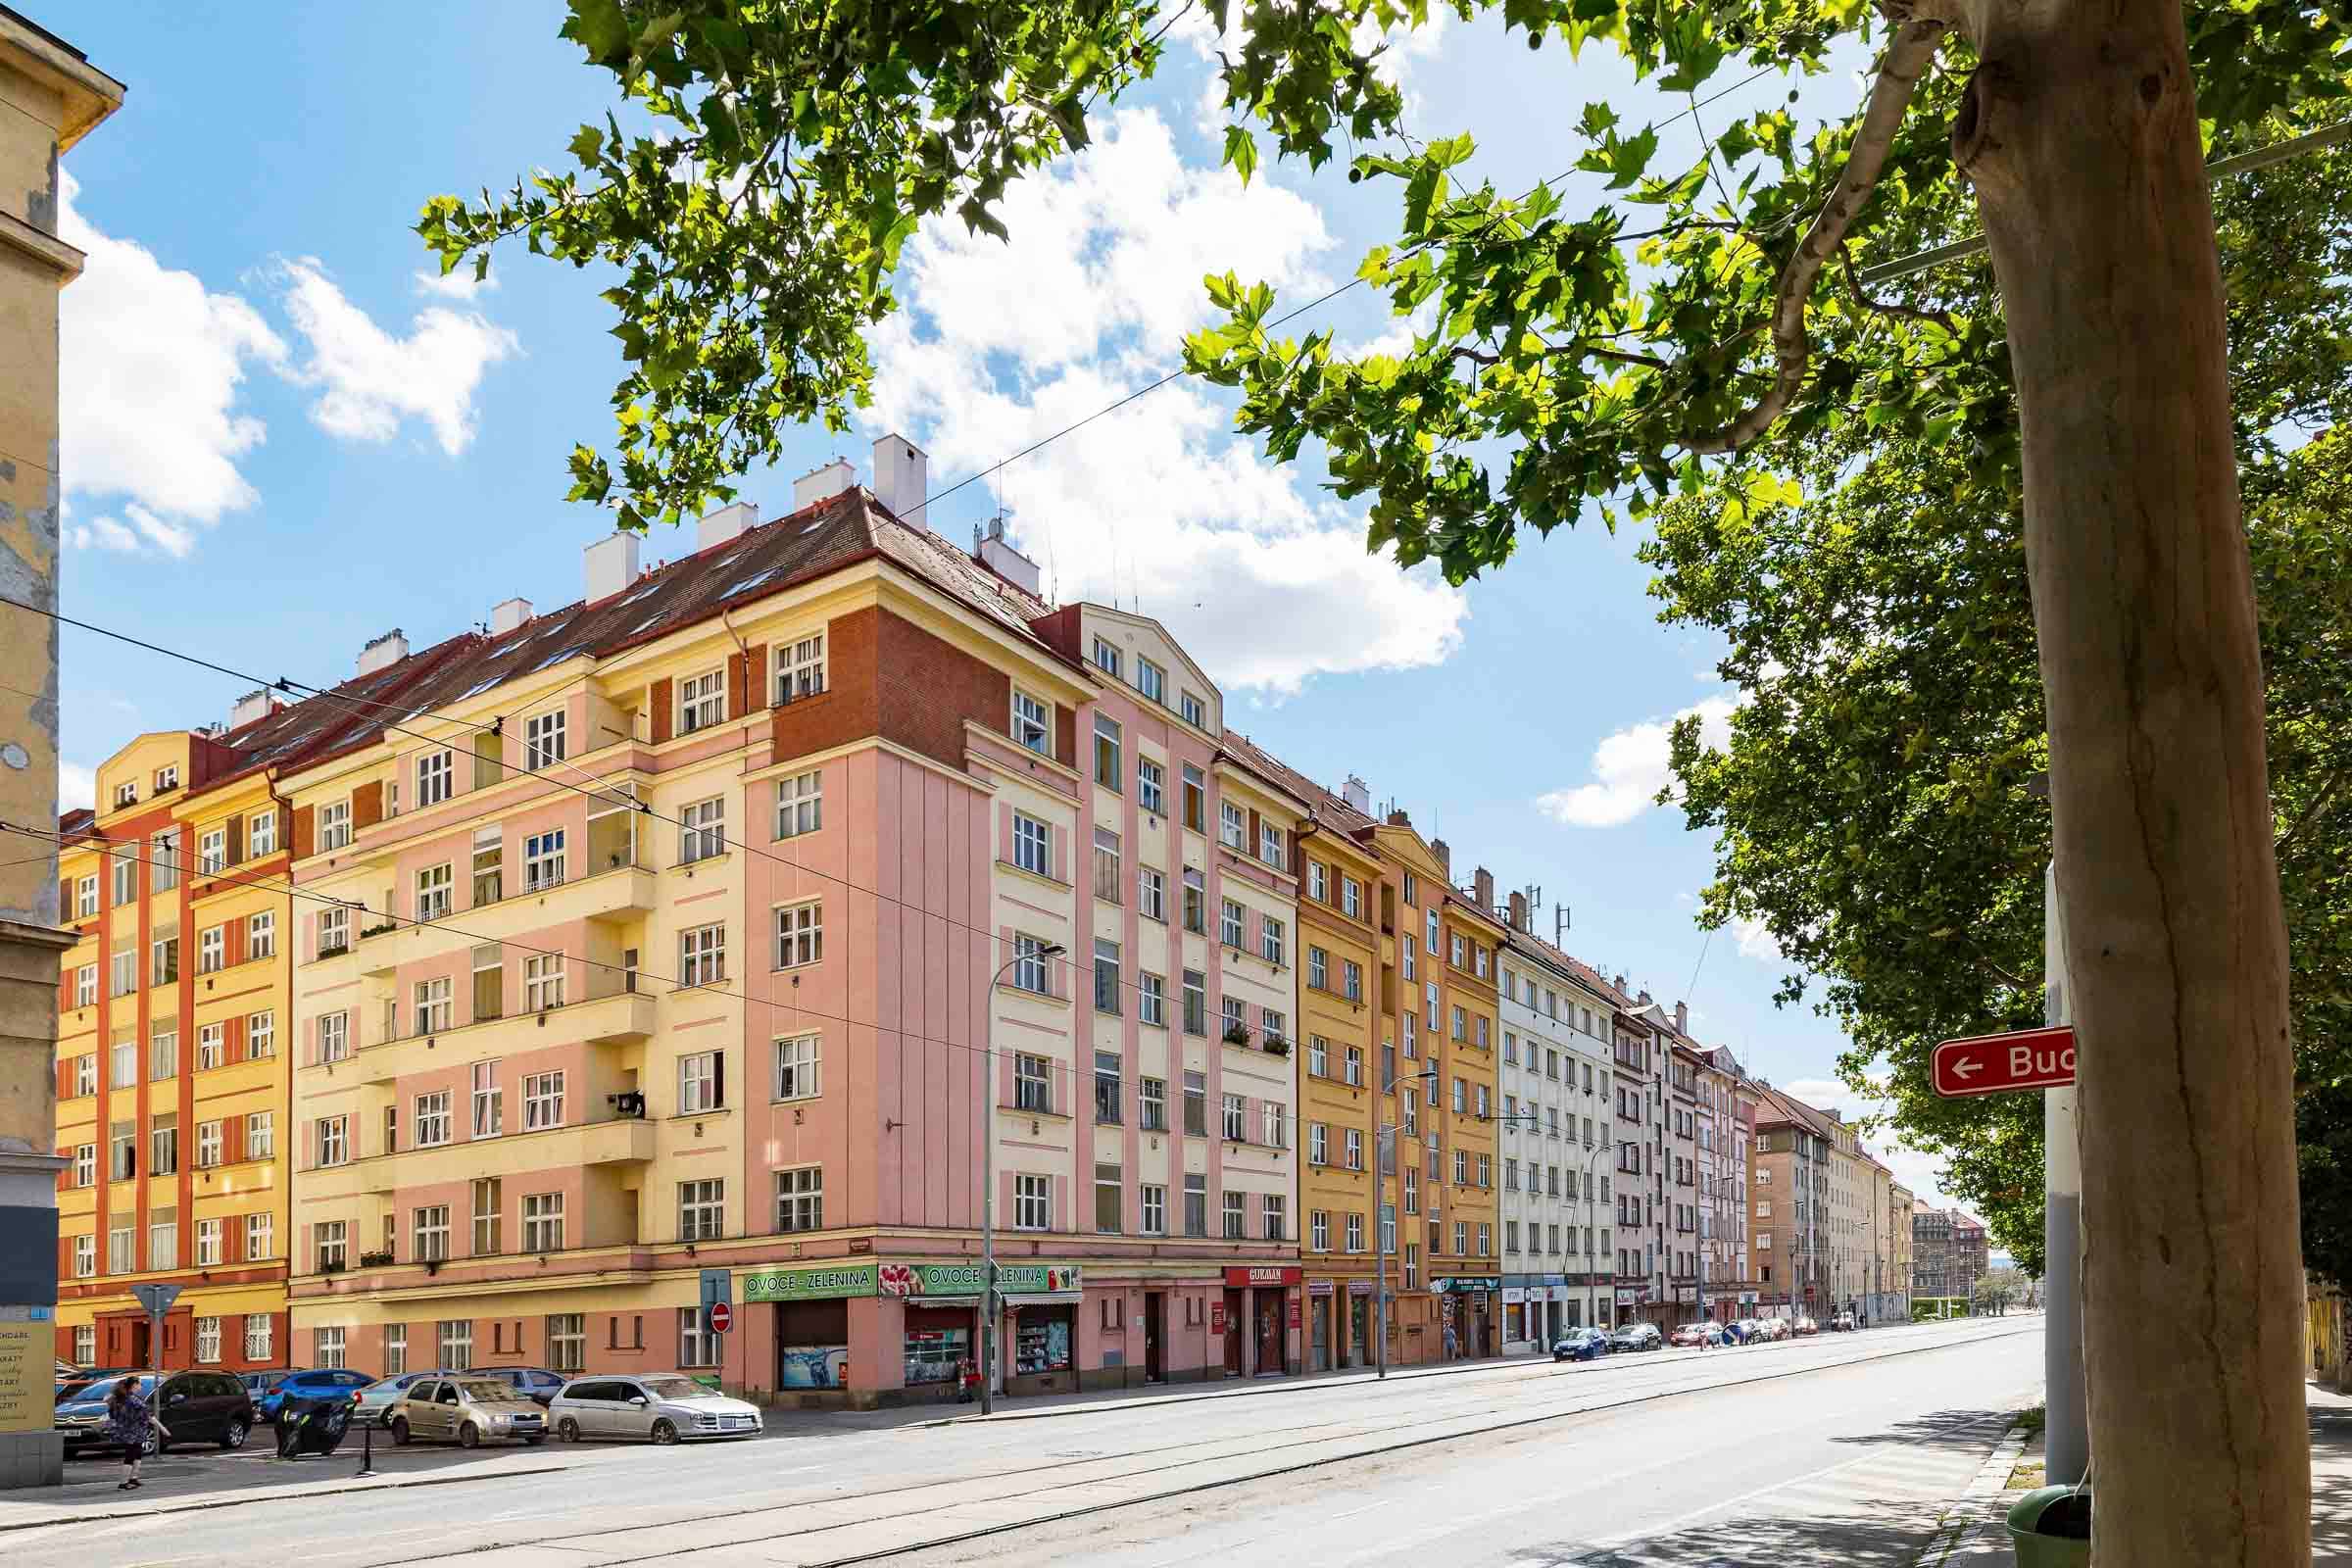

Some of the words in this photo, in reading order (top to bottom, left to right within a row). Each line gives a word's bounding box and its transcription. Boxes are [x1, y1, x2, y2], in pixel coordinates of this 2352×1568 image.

[747, 1276, 796, 1292] OVOCE
[808, 1269, 870, 1288] ZELENINA
[929, 1268, 980, 1284] OVOCE
[996, 1268, 1044, 1283] LENINA
